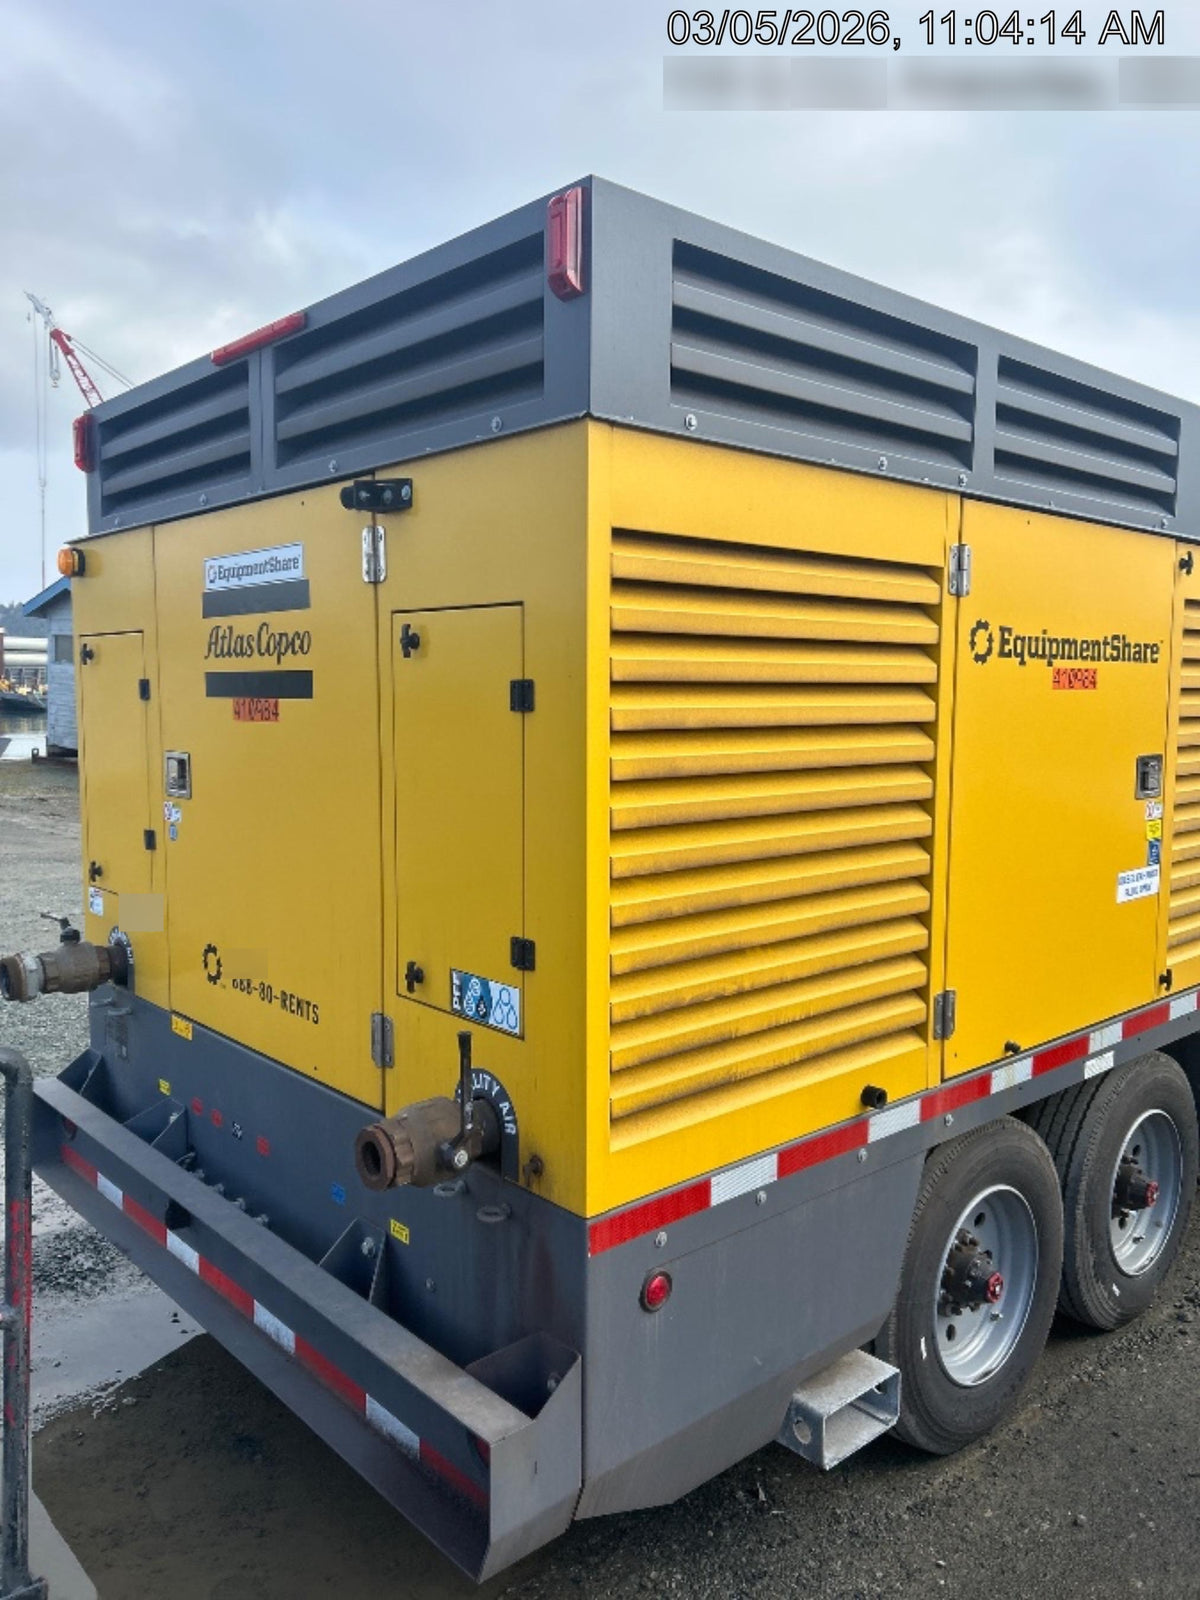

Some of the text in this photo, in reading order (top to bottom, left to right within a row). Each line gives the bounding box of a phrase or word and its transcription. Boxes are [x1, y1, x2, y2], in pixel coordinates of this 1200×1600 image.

[217, 556, 300, 583] EquipmentShare
[998, 625, 1161, 667] EquipmentShare
[499, 1101, 517, 1135] AIR
